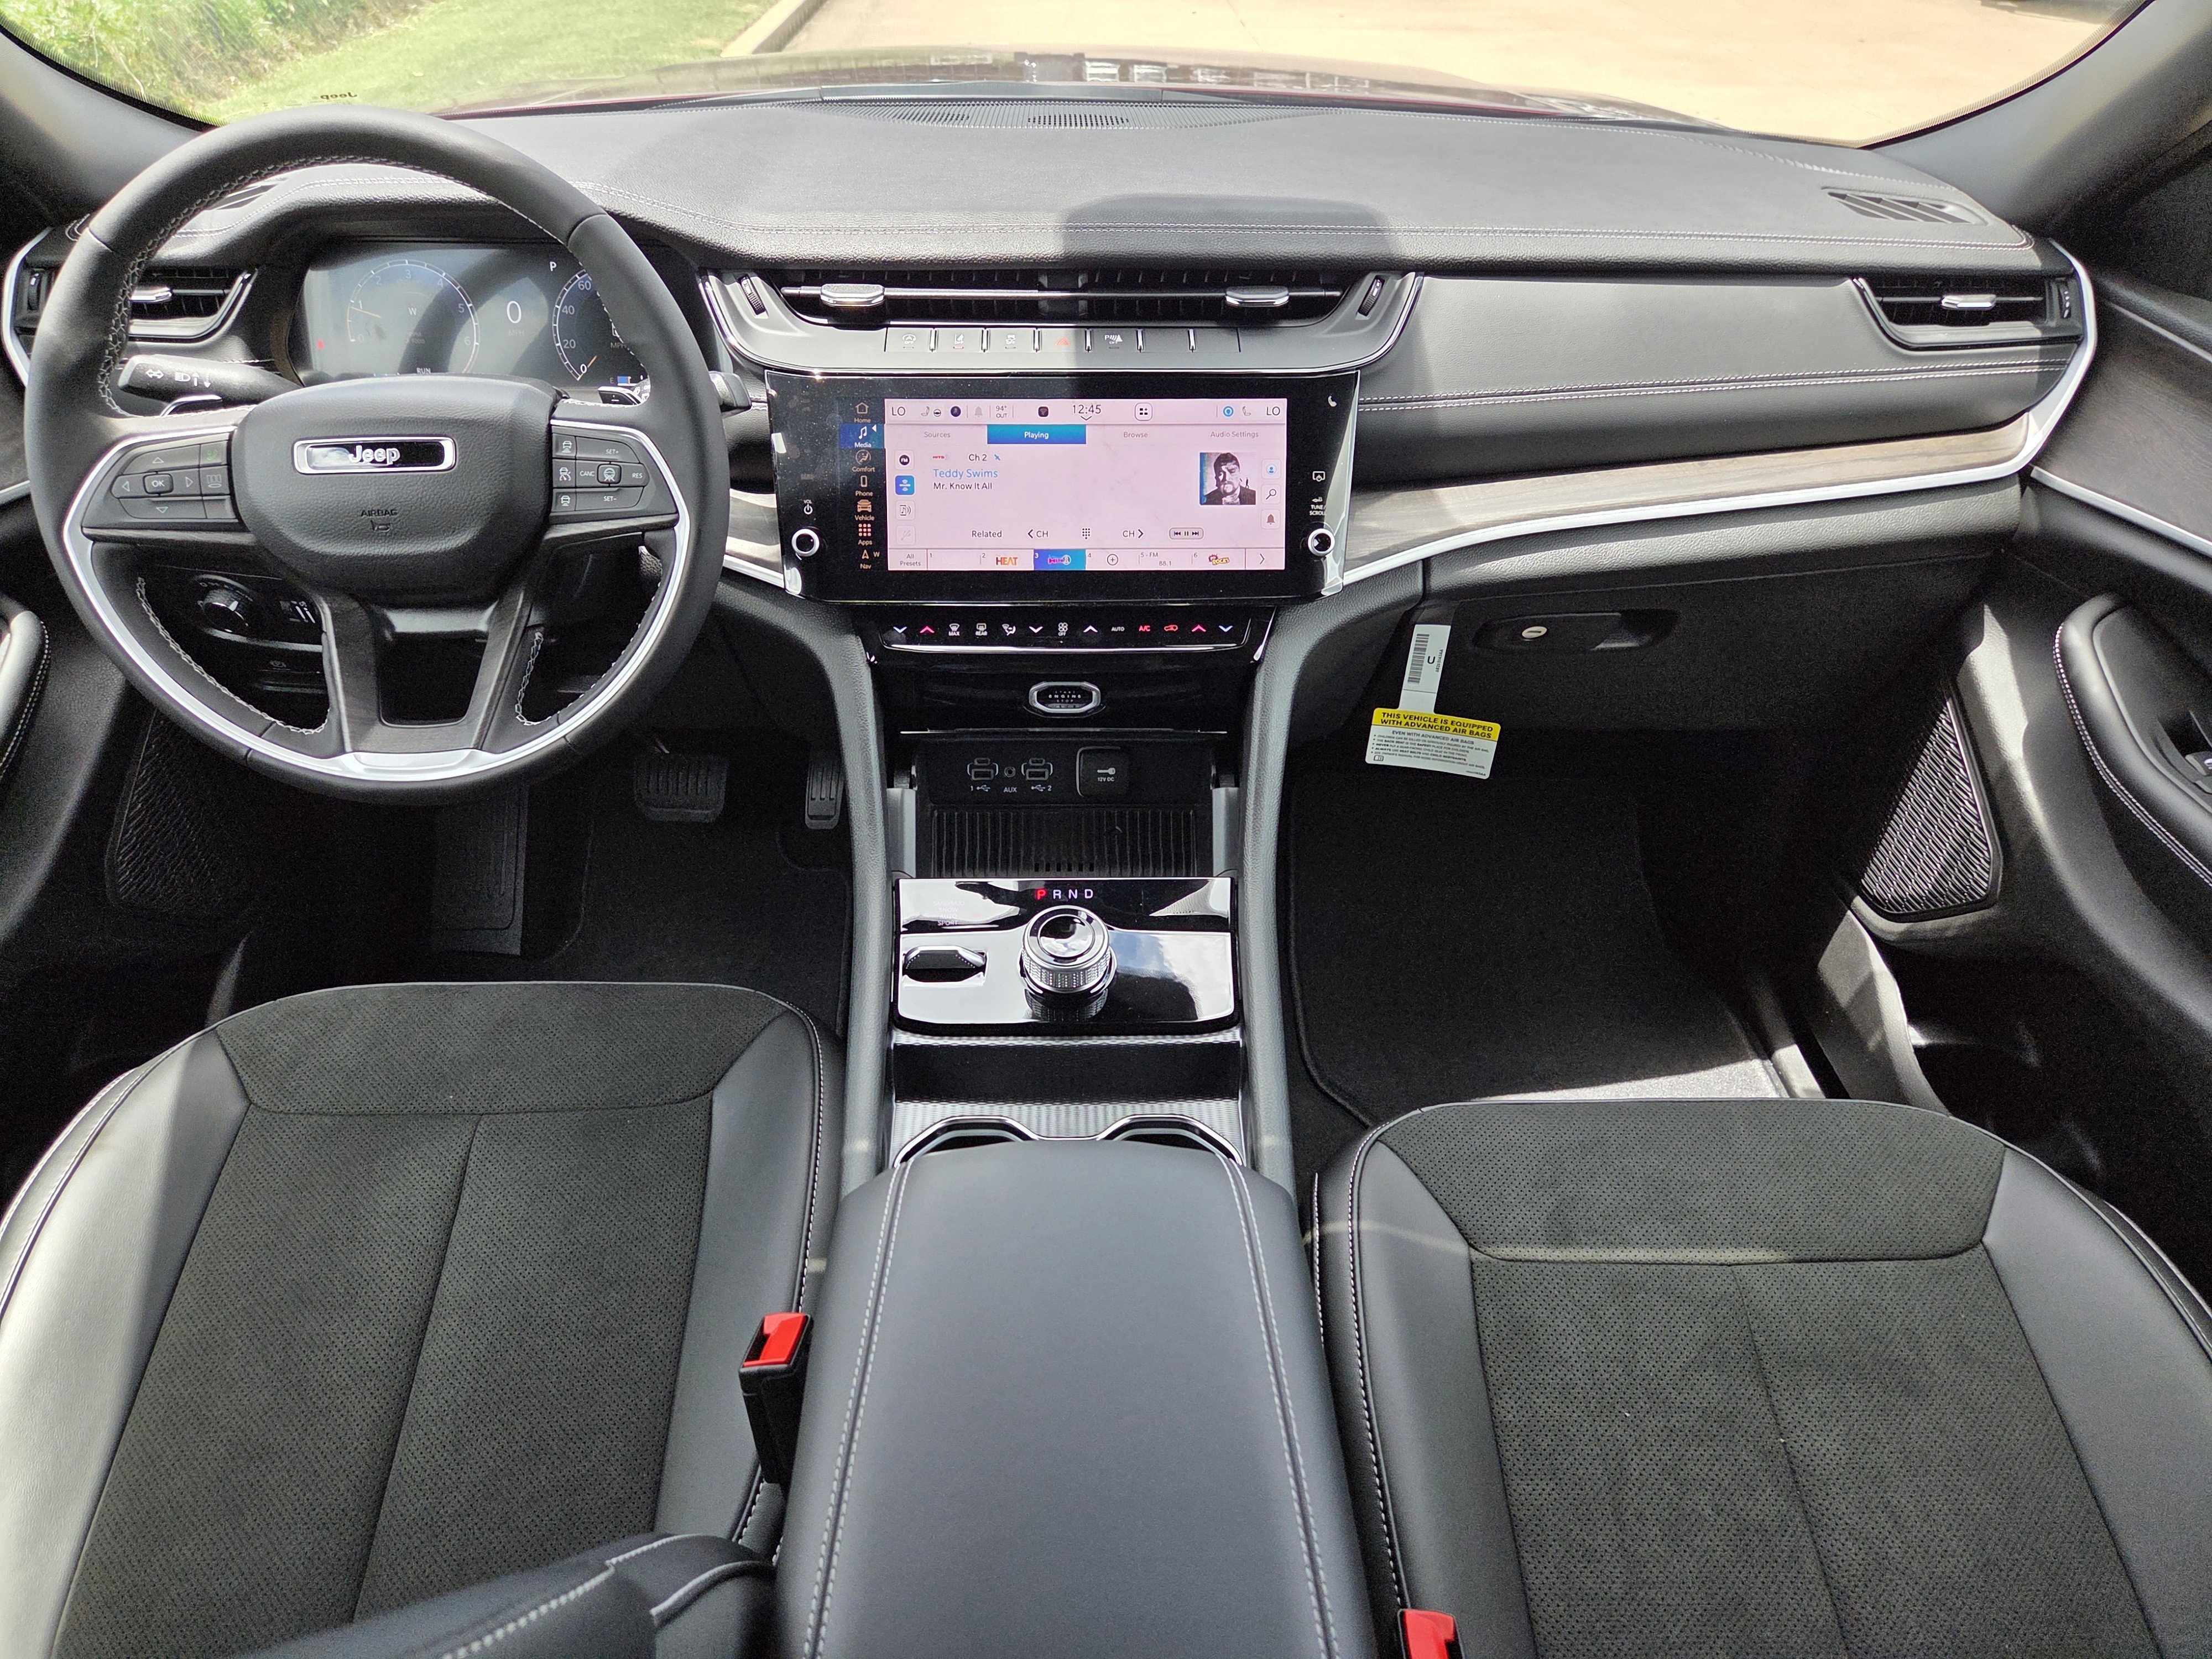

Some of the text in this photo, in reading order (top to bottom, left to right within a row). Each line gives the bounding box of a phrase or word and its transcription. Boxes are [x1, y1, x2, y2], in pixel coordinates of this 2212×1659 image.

[550, 262, 557, 272] P
[405, 269, 411, 279] 3
[375, 275, 382, 285] 2
[436, 278, 444, 288] 4
[578, 280, 592, 291] 60
[458, 304, 465, 313] 5
[507, 300, 521, 324] 0
[562, 305, 575, 315] 40
[464, 336, 471, 345] 6
[563, 339, 576, 349] 20
[580, 363, 587, 374] 0
[891, 406, 906, 416] LO
[1072, 404, 1102, 414] 12:45
[1266, 406, 1281, 416] LO
[1024, 431, 1049, 440] Playing
[348, 445, 400, 465] Jeep
[933, 468, 998, 479] Teddy Swims
[152, 479, 165, 488] OK
[361, 509, 398, 518] AIRBAG
[995, 556, 1018, 566] HEAT
[1427, 656, 1436, 664] U
[1403, 714, 1438, 724] VEHICLE
[1451, 720, 1493, 732] EQUIPPED
[1404, 721, 1451, 732] ADVANCED
[1469, 730, 1492, 739] BAGS
[1036, 889, 1093, 900] P R N D
